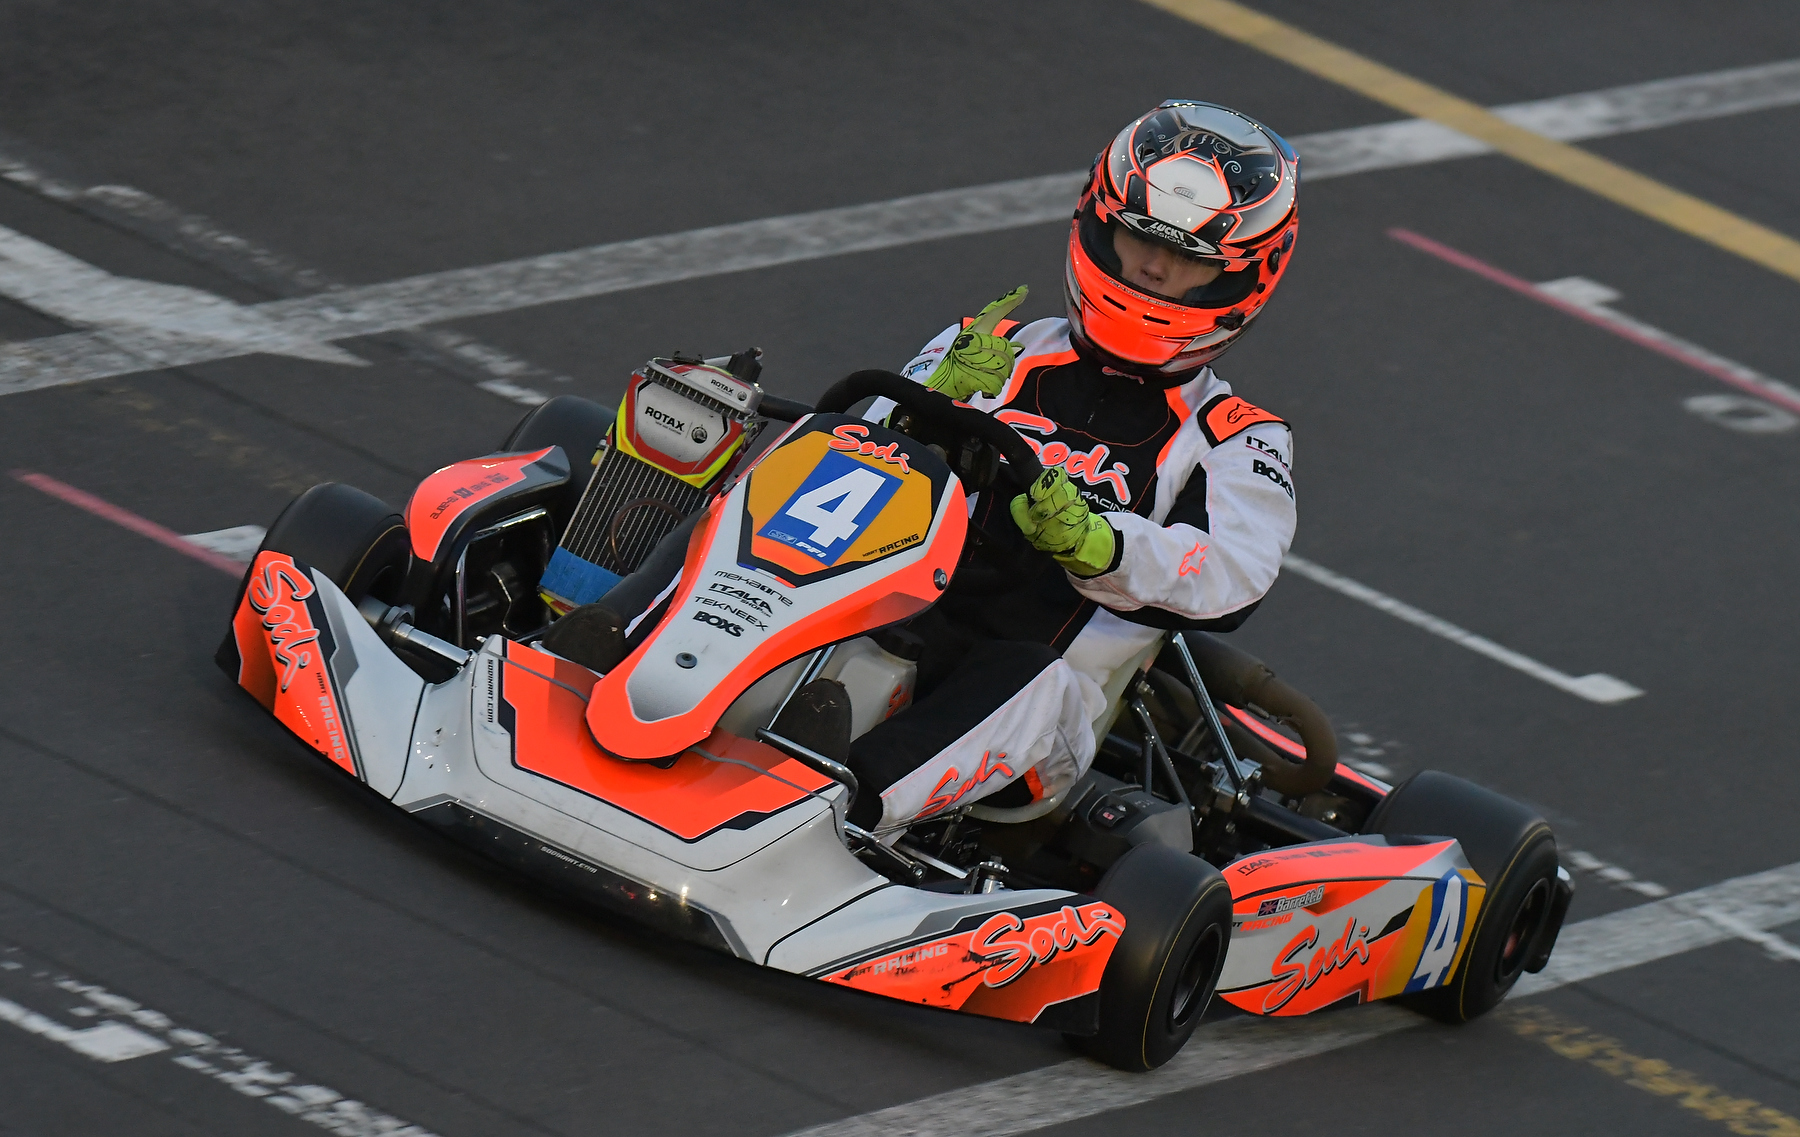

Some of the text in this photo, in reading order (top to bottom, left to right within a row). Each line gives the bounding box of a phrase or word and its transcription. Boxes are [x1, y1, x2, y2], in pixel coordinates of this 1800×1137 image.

[1144, 226, 1188, 247] DESIGN
[1150, 221, 1185, 241] LUCKY
[710, 379, 735, 394] ROTAX
[644, 406, 686, 432] ROTAX
[827, 424, 910, 474] Sodi
[1246, 435, 1292, 474] ITAK
[785, 467, 887, 549] 4
[879, 533, 920, 555] RACING
[694, 596, 769, 631] TEKNEEX
[709, 583, 774, 614] ITAKA
[249, 560, 320, 693] Sodi
[692, 610, 745, 637] BOXS
[318, 696, 346, 760] RACING
[1240, 912, 1294, 932] RACING
[1413, 875, 1459, 990] 4
[873, 943, 949, 976] RACING
[968, 905, 1122, 989] Sodi
[1262, 916, 1370, 1014] Sodi
